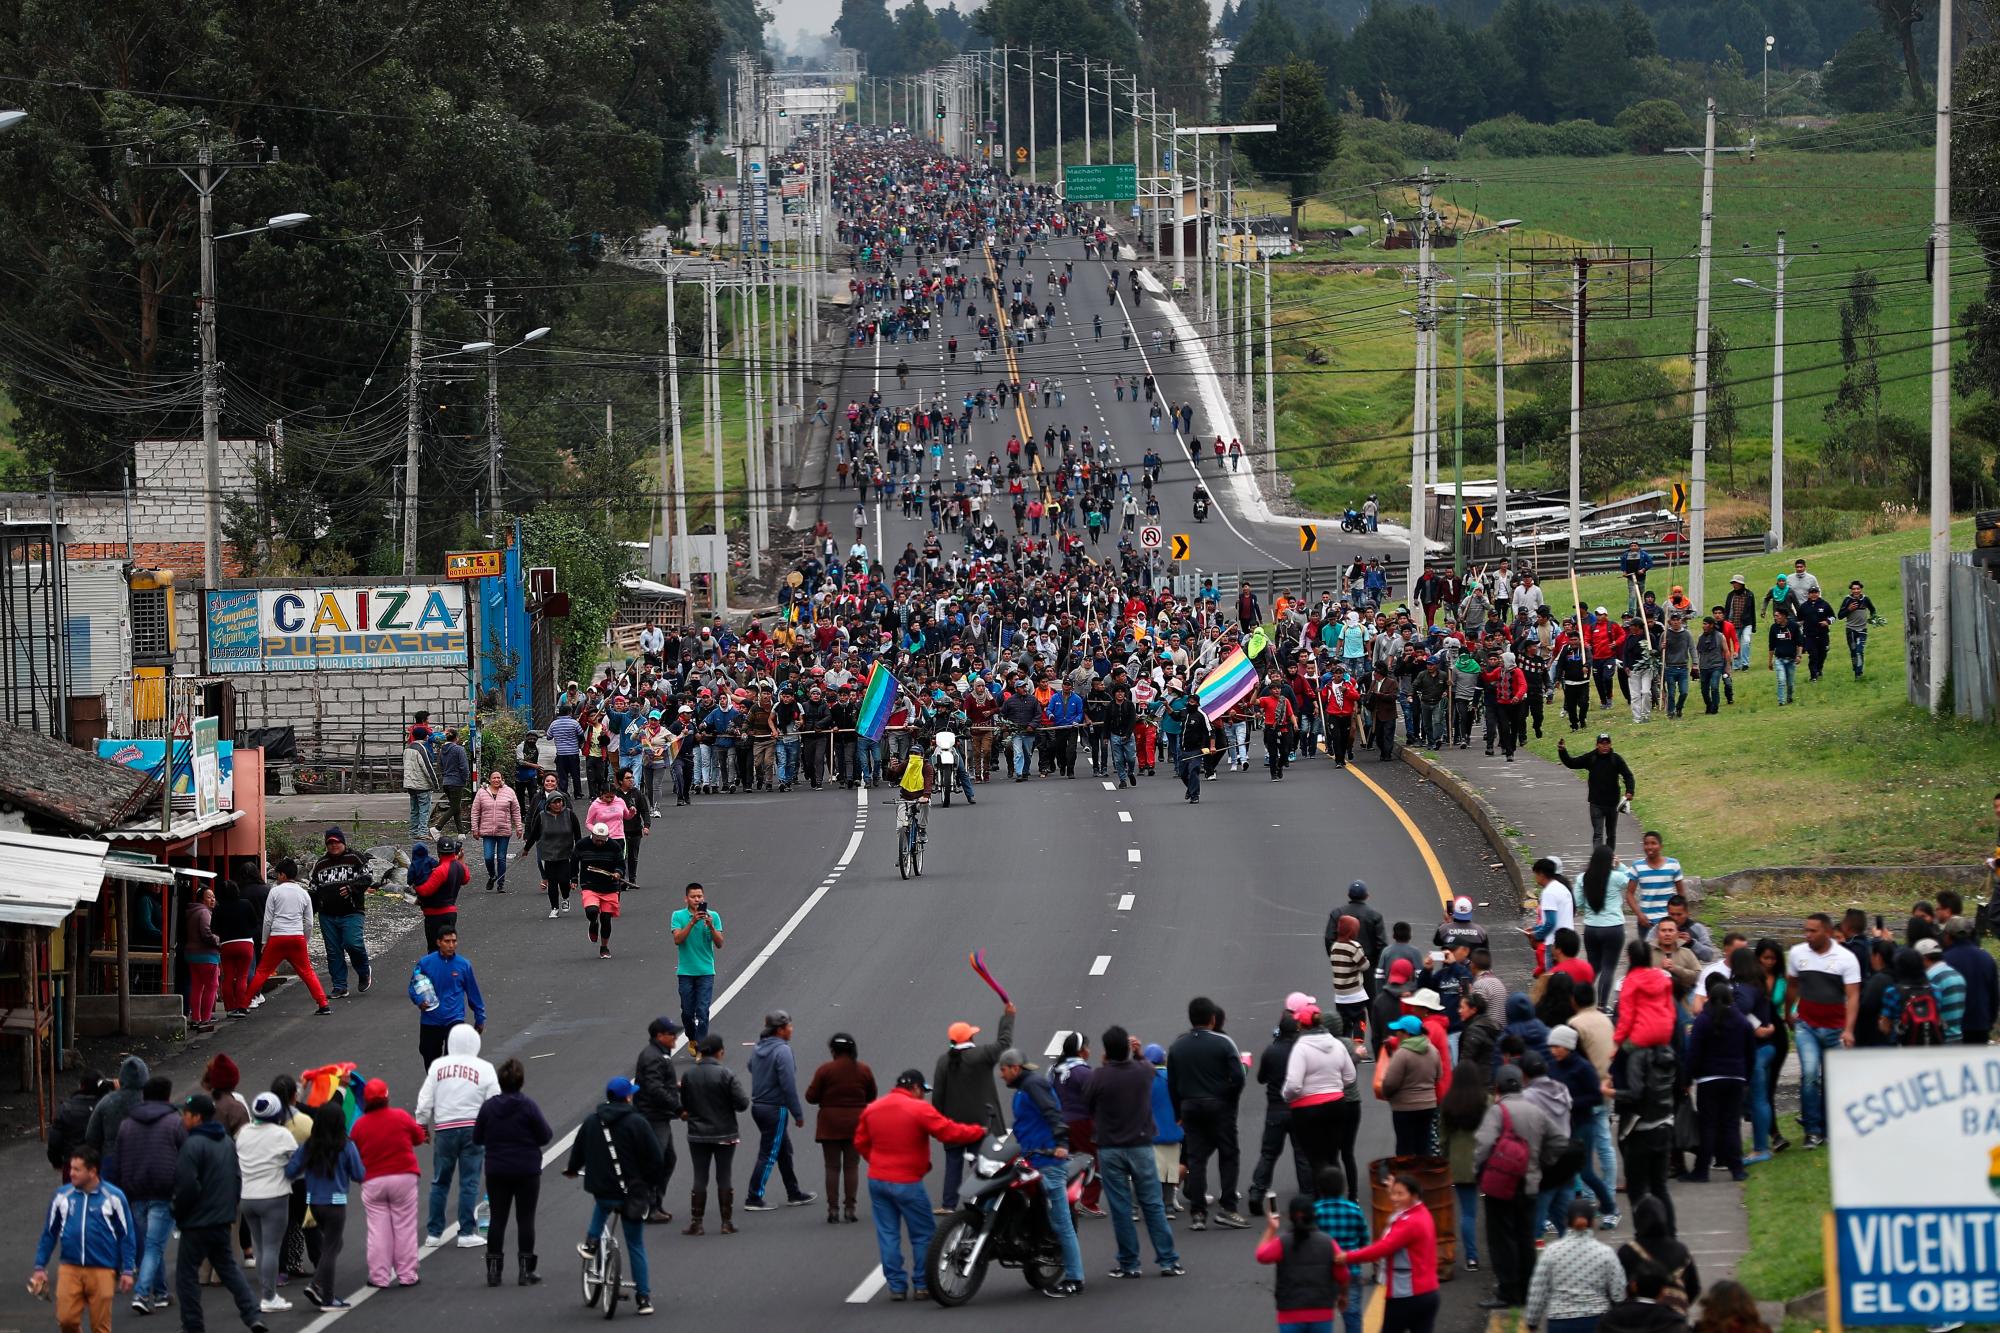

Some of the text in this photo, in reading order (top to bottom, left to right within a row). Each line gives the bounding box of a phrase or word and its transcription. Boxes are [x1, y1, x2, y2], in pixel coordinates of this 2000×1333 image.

[449, 556, 484, 568] ARTE
[273, 590, 458, 633] CAIZA
[266, 635, 366, 657] PUBLI
[211, 658, 269, 673] PANCARTAS
[272, 658, 316, 671] ROTULOS
[318, 657, 364, 669] MURALES
[366, 656, 409, 668] PINTURA
[422, 654, 466, 666] GENERAL
[437, 1064, 480, 1086] HILFIGER
[1845, 1064, 1979, 1137] ESCUELA
[1851, 1281, 1906, 1313] EL
